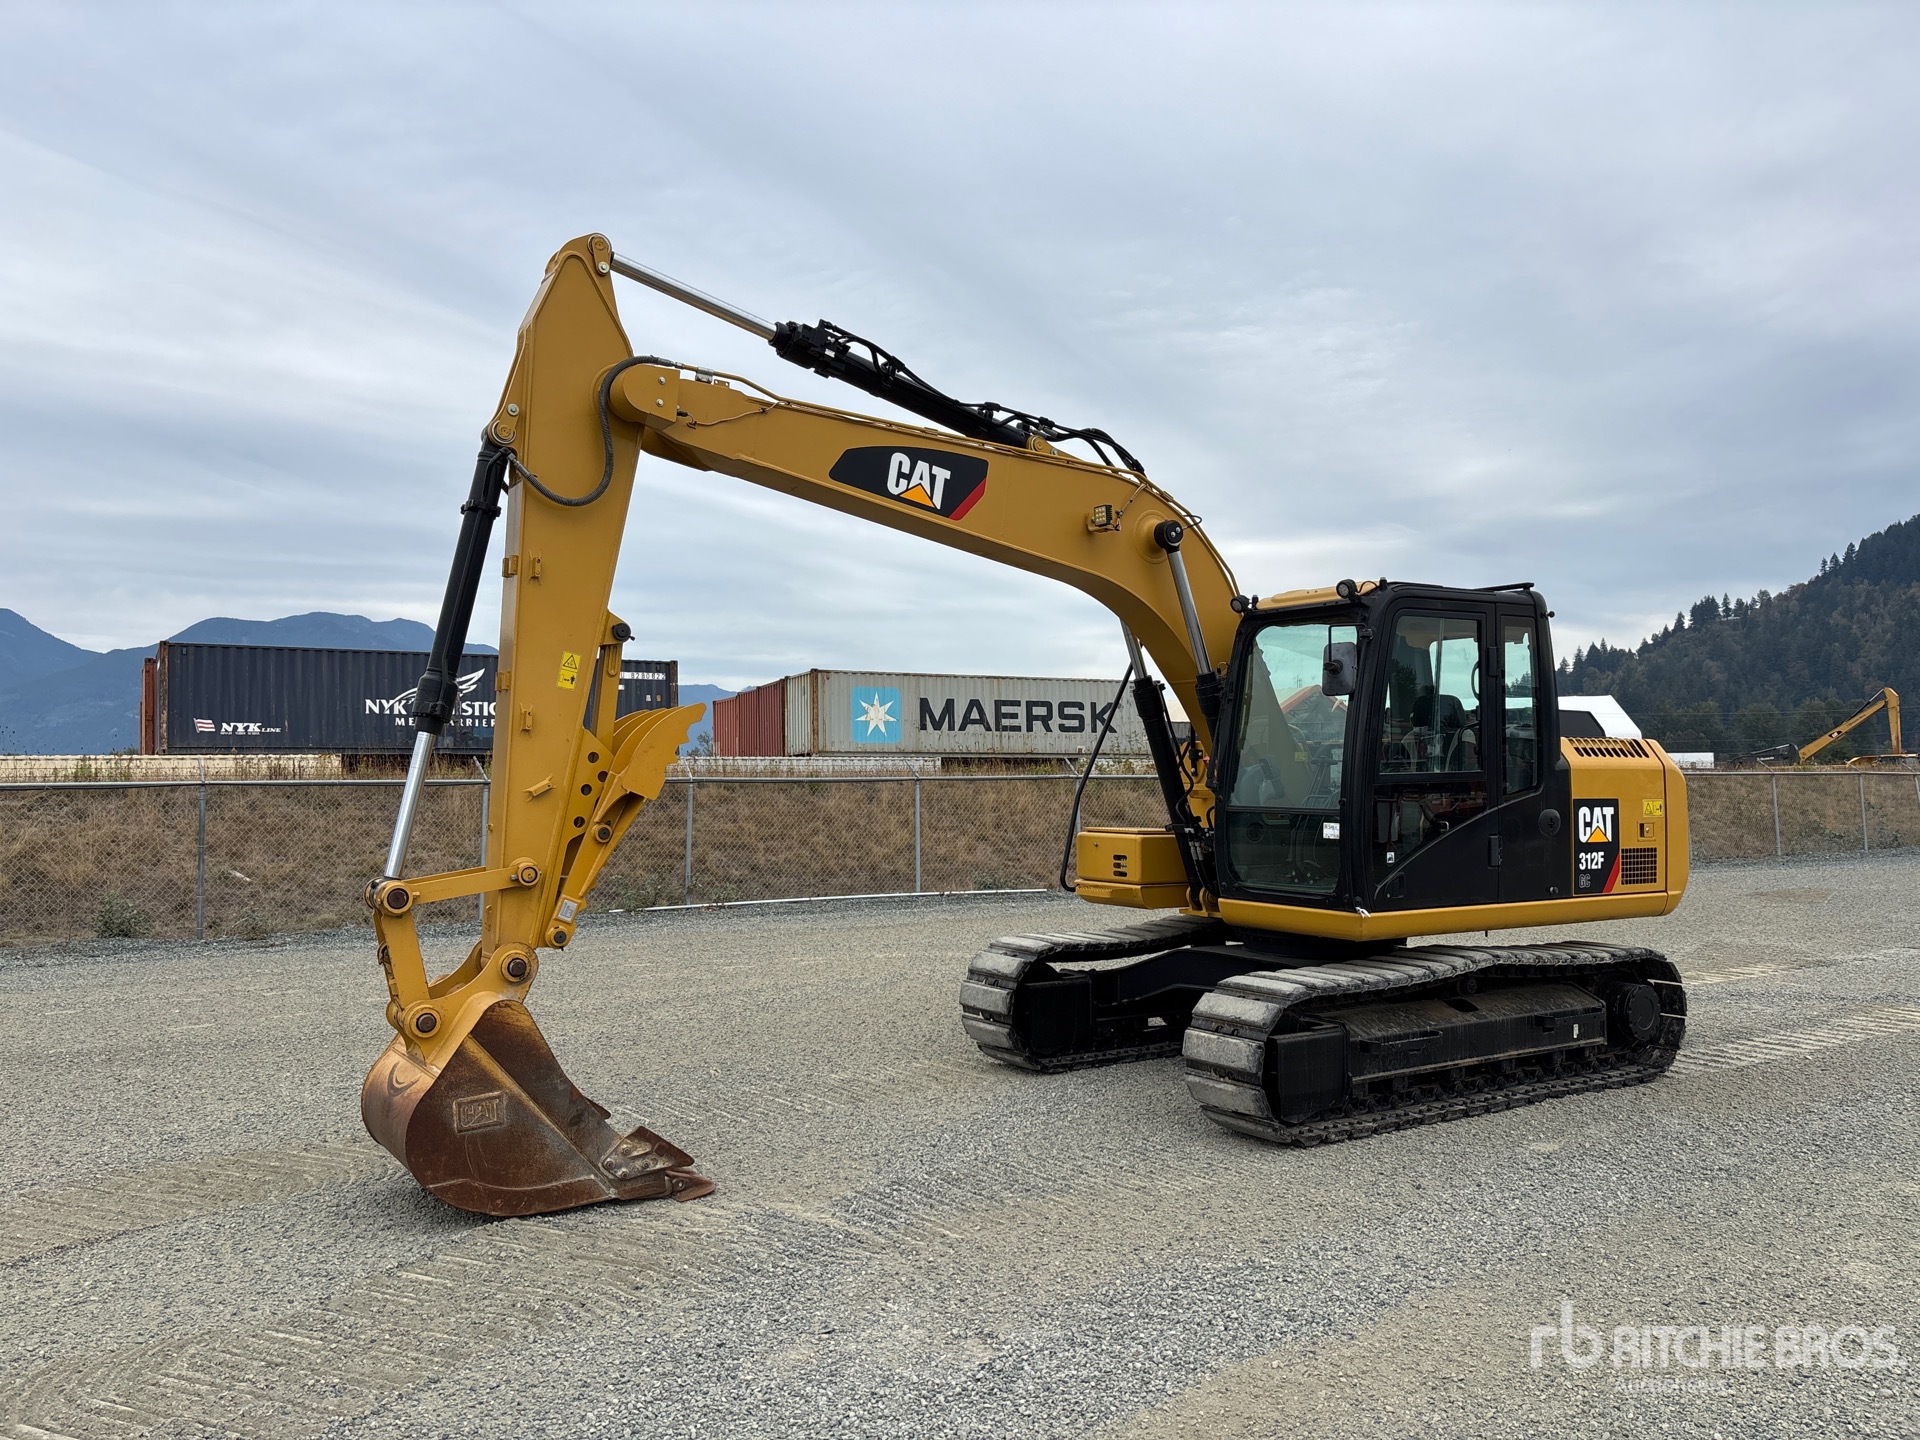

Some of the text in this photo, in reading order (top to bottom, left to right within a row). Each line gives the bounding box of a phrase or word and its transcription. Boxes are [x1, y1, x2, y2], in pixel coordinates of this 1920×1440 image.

[887, 452, 951, 510] CAT
[365, 699, 408, 714] NYK
[919, 697, 1117, 734] MAERSK
[221, 722, 262, 732] NYK
[1578, 806, 1615, 843] CAT
[1579, 852, 1604, 870] 312F
[1579, 874, 1590, 888] GC
[461, 1099, 499, 1127] CAT
